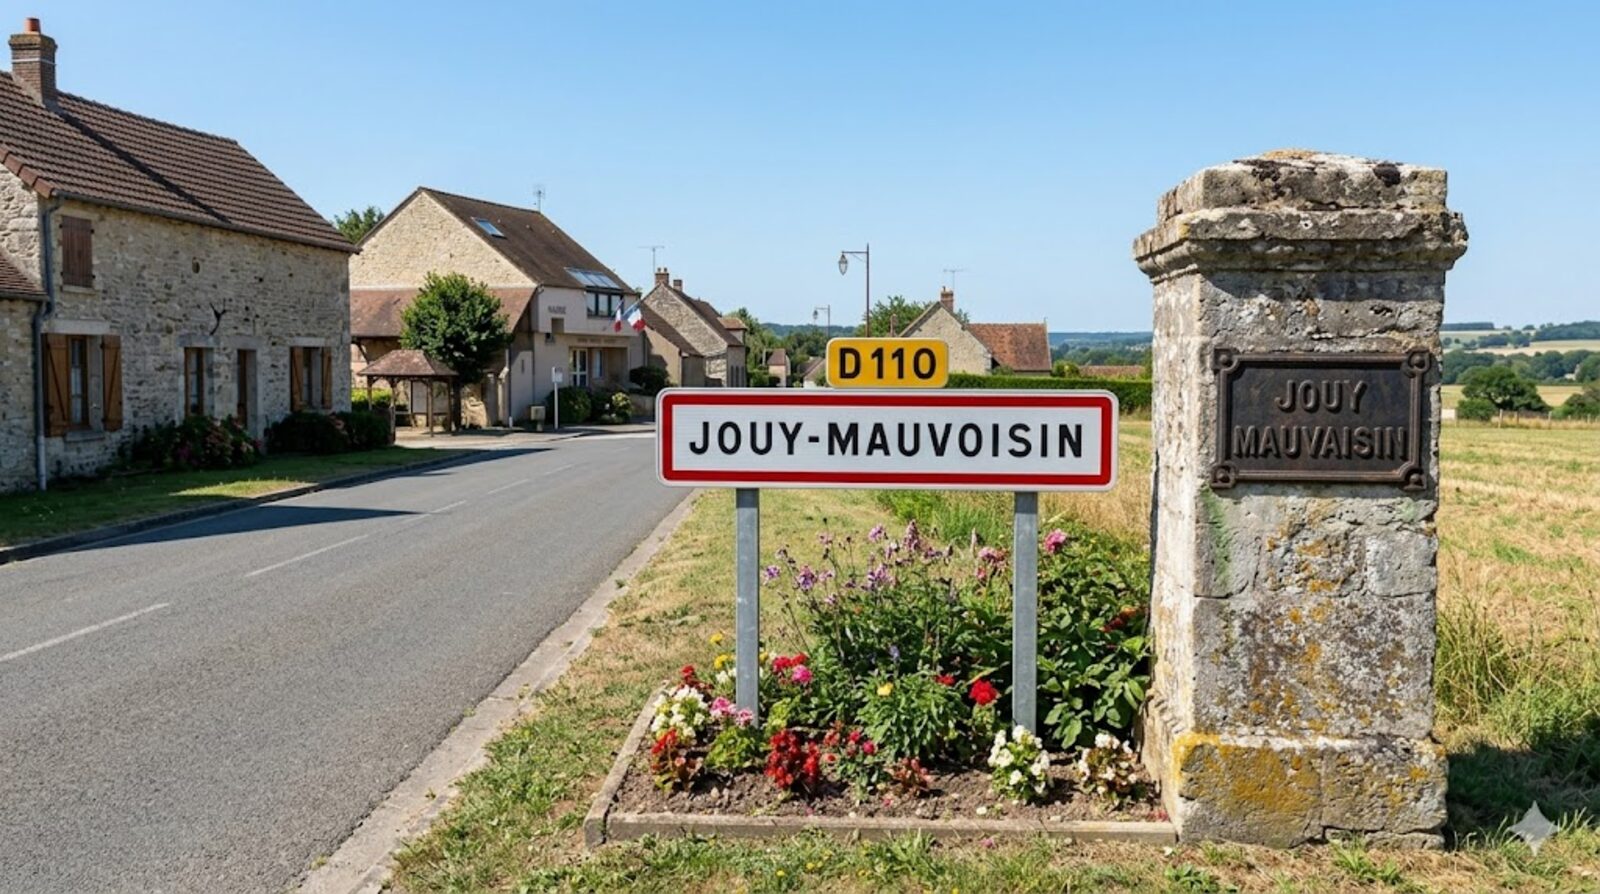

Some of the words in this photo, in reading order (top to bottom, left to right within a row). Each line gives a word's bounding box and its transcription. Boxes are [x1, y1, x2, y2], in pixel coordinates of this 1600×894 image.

[839, 347, 862, 380] D
[871, 347, 937, 380] 110
[1274, 379, 1368, 413] JOUY
[689, 421, 1083, 458] JOUY-MAUVOISIN
[1233, 425, 1408, 459] MAUVAISIN
